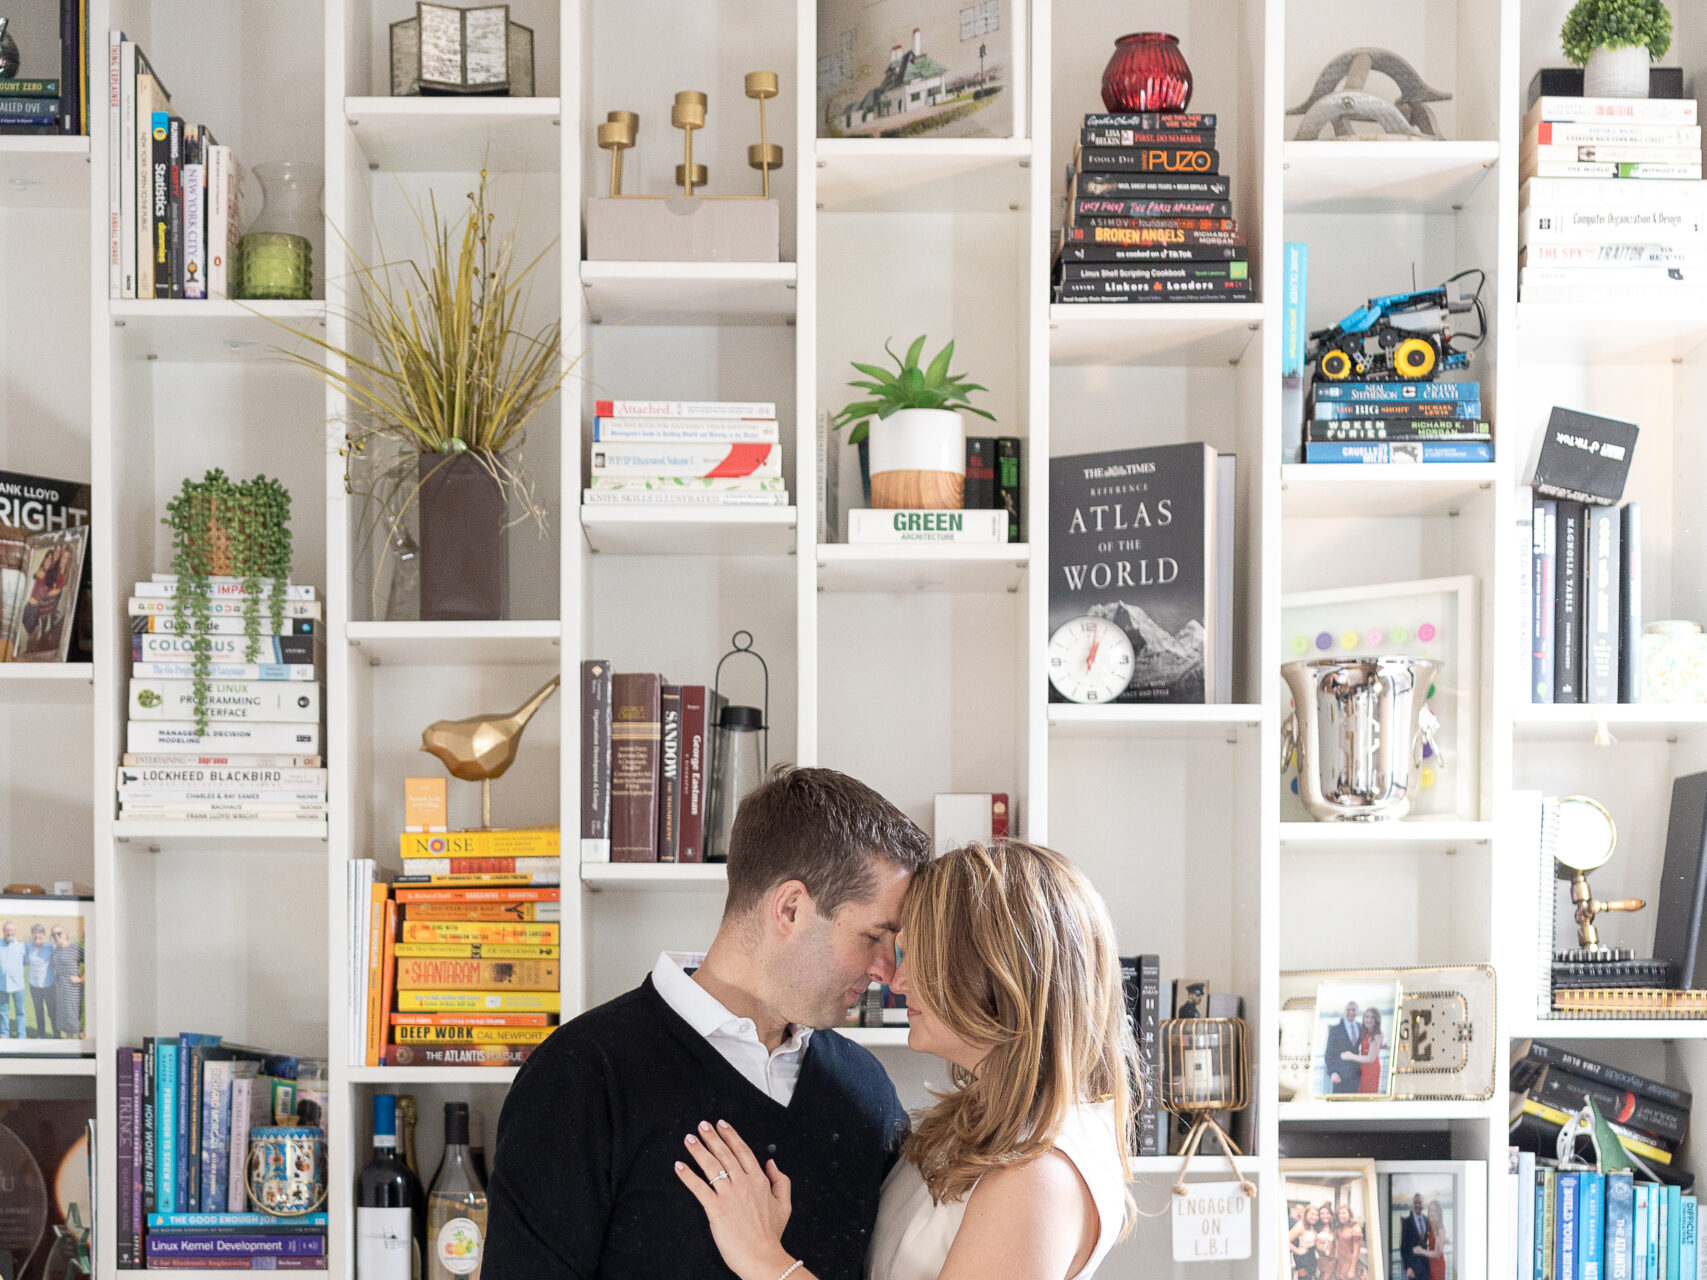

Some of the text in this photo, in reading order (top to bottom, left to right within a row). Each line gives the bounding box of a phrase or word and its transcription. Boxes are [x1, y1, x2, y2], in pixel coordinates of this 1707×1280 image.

[170, 121, 178, 158] RUNNING
[1095, 137, 1120, 145] BELKIN
[1150, 150, 1211, 171] PUZO
[154, 162, 167, 217] Statistics
[188, 168, 198, 256] NEW YORK CITY
[1573, 213, 1606, 226] Computer
[1658, 213, 1682, 226] Design
[157, 222, 168, 263] dummies
[1094, 228, 1184, 243] BROKEN ANGELS
[1168, 250, 1192, 258] TikTok
[1539, 248, 1582, 259] THE SPY
[1081, 268, 1099, 278] Linux
[1101, 268, 1118, 278] Shell
[1120, 268, 1150, 280] Scripting
[1151, 268, 1186, 278] Cookbook
[1105, 281, 1149, 292] Linkers
[1167, 280, 1213, 291] Loaders
[1423, 390, 1458, 399] CRASH
[1355, 405, 1380, 414] BIG
[1328, 421, 1384, 429] WOKEN
[1127, 463, 1156, 474] TIMES
[24, 486, 59, 502] LLOYD
[894, 512, 963, 532] GREEN
[1069, 500, 1172, 534] ATLAS
[1098, 539, 1142, 552] OF THE
[1566, 518, 1574, 576] MAGNOLIA
[1063, 558, 1178, 592] WORLD
[217, 684, 248, 692] LINUX
[664, 710, 678, 780] SANDOW
[592, 746, 600, 782] Development
[143, 771, 280, 782] LOCKHEED BLACKBIRD
[690, 735, 702, 816] George Eastman
[411, 960, 480, 984] SHANTARAM
[400, 1027, 430, 1038] DEEP
[434, 1027, 474, 1038] WORK
[498, 1032, 543, 1040] NEWPORT
[426, 1050, 522, 1062] THE ATLANTIS PLAGUE
[1562, 1054, 1581, 1067] BLUE
[1583, 1060, 1601, 1074] ZIMA
[120, 1096, 132, 1147] PRINCE
[210, 1109, 220, 1148] MORGAN
[145, 1104, 153, 1193] HOW WOMEN RISE
[162, 1088, 171, 1193] PERMISSION TO SCREW UP
[1178, 1196, 1244, 1216] ENGAGED
[1563, 1187, 1574, 1221] BUILD
[170, 1216, 276, 1224] THE GOOD ENOUGH JOB
[1201, 1218, 1221, 1235] ON
[1563, 1222, 1573, 1251] YOUR
[152, 1240, 282, 1254] Linux Kernel Development
[1614, 1218, 1626, 1278] THE ATLANTIS
